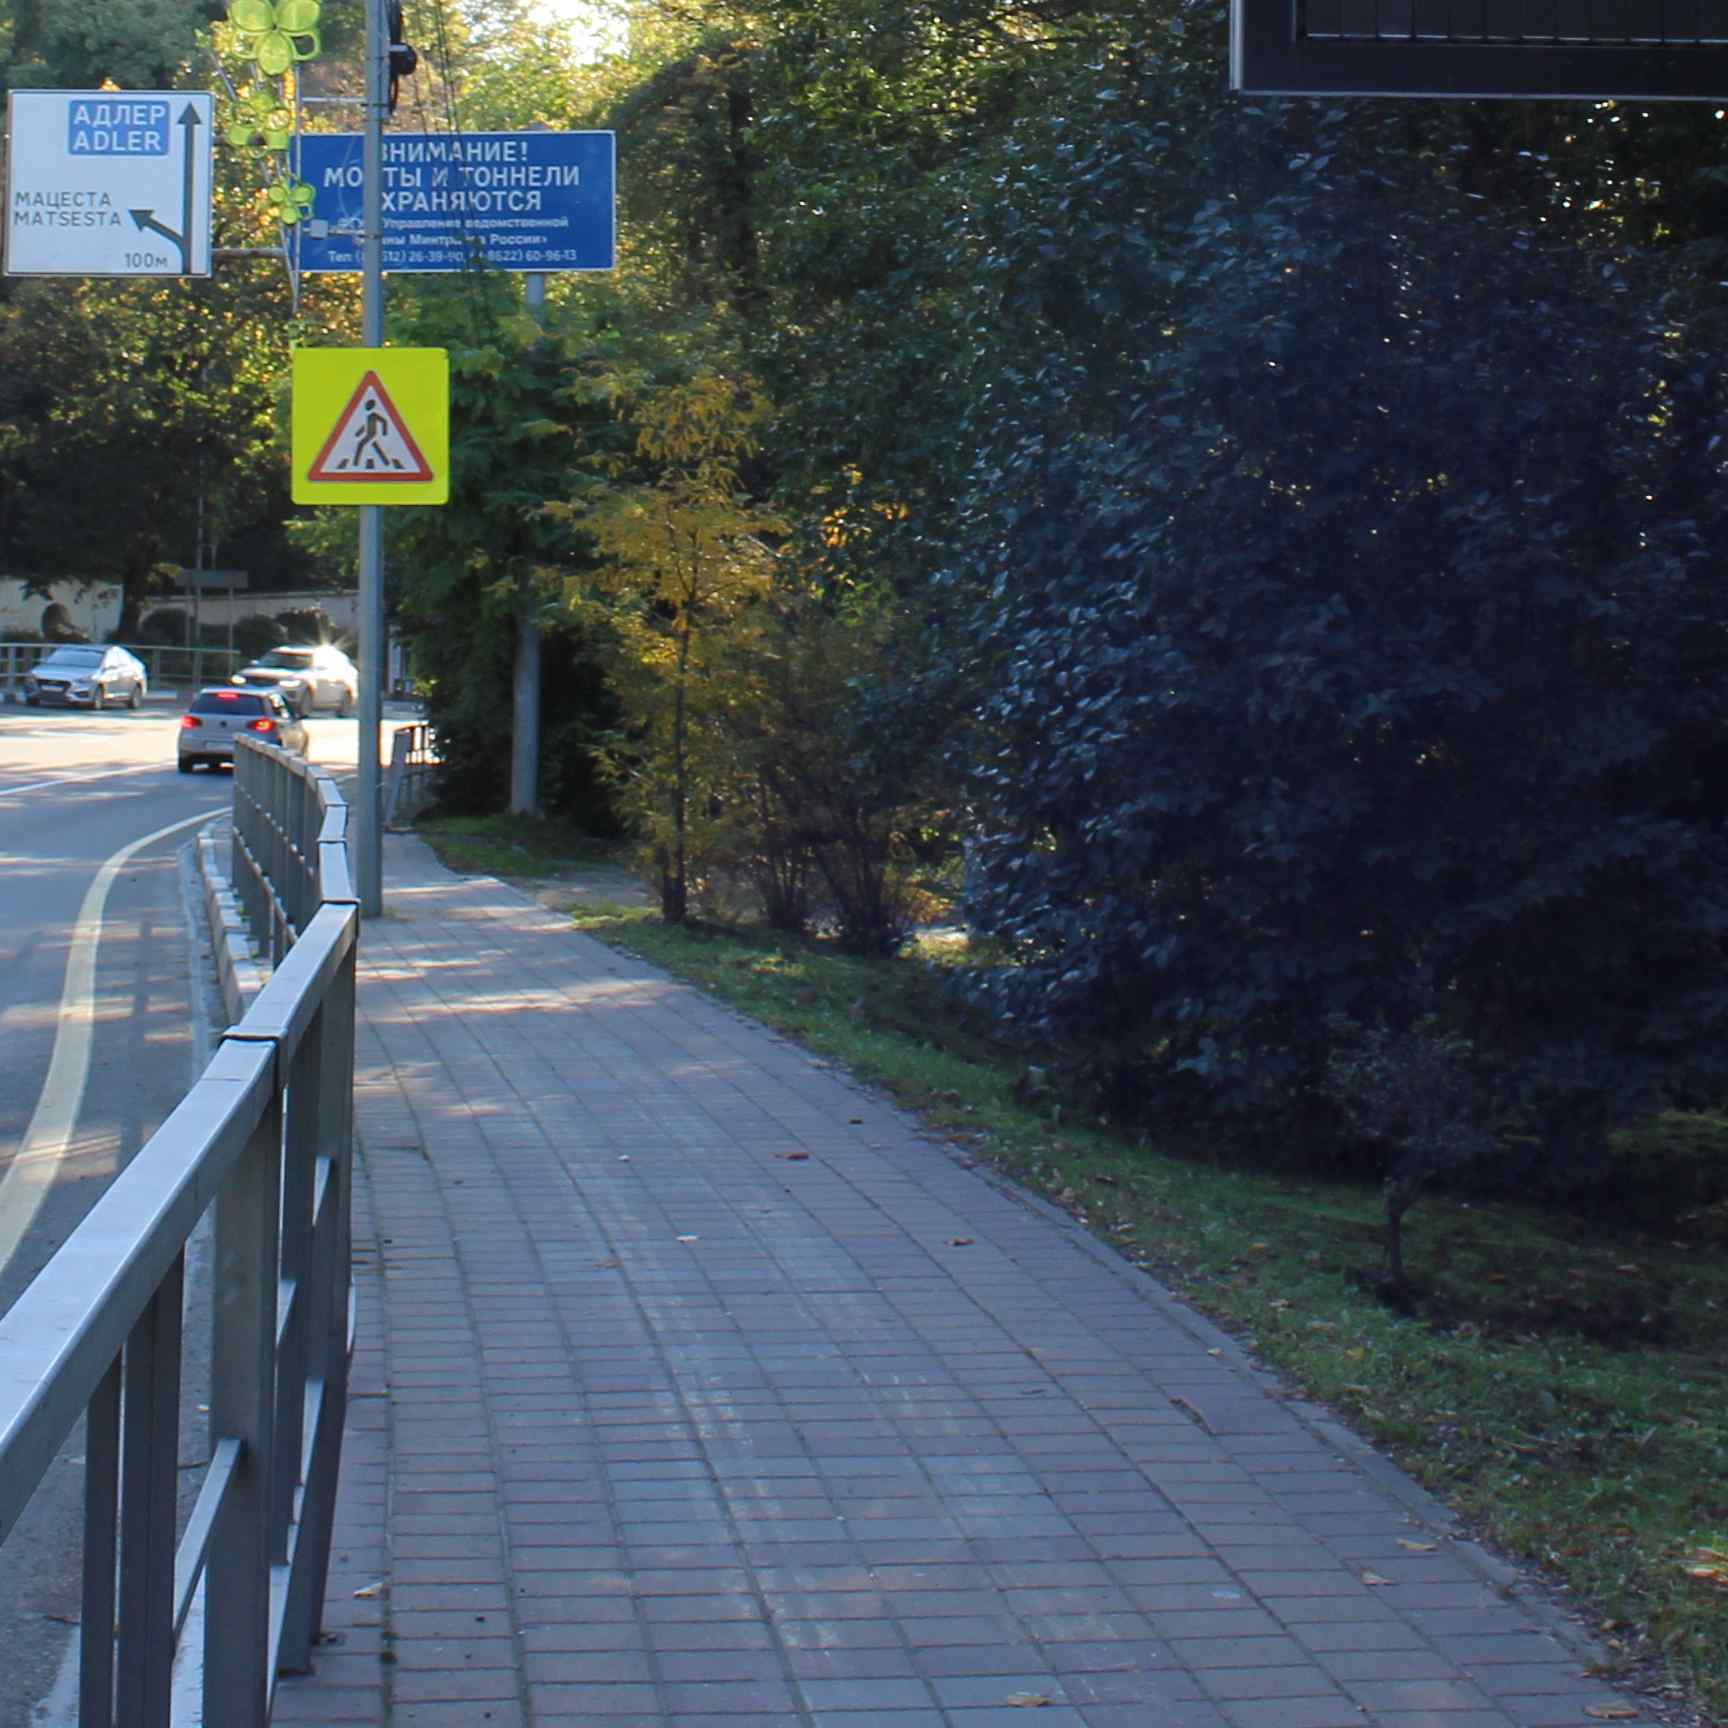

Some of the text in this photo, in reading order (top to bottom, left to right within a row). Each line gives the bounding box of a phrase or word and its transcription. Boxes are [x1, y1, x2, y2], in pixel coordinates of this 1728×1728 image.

[73, 104, 166, 129] АДЛЕР
[73, 130, 161, 151] ADLER
[323, 165, 580, 188] МОТЫ И ТОННЕЛИ
[14, 191, 112, 208] МАЦЕСТА
[379, 190, 542, 212] ХРАНЯЮТСЯ
[14, 211, 122, 227] MATSESTA
[124, 252, 169, 268] 100м
